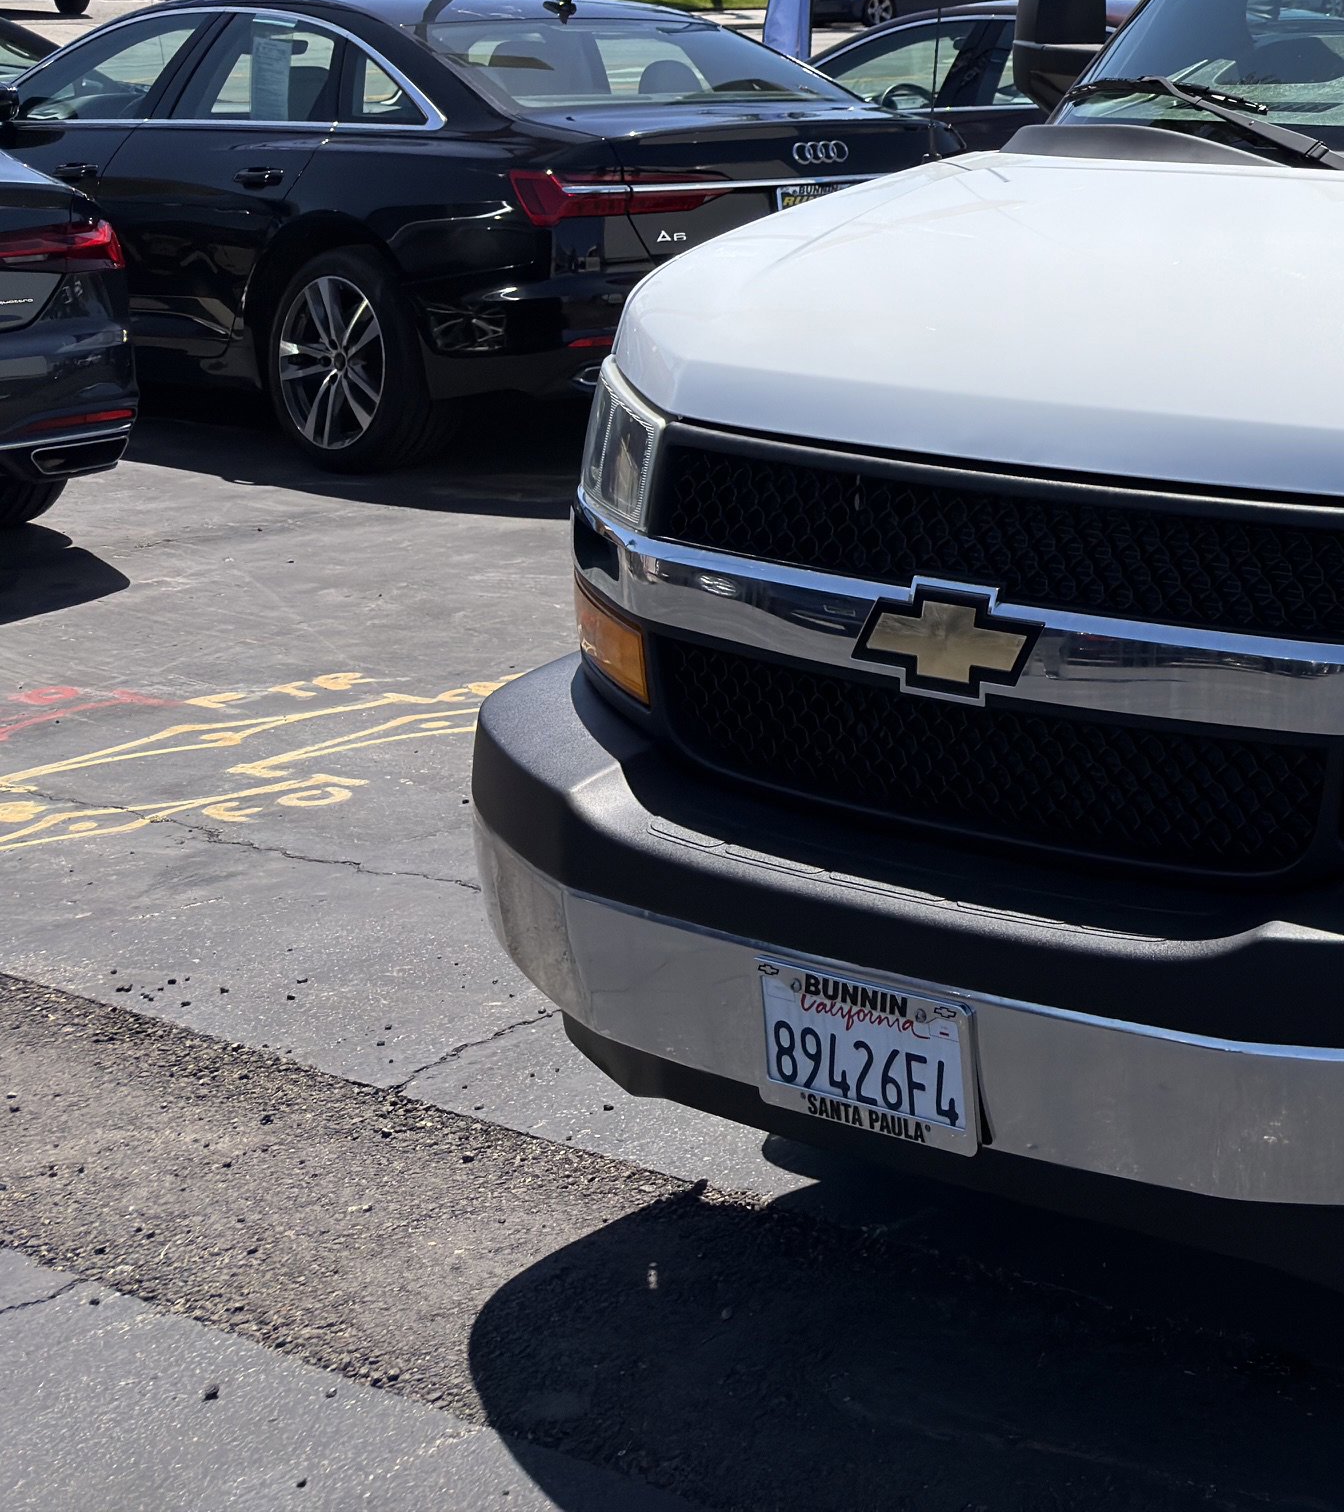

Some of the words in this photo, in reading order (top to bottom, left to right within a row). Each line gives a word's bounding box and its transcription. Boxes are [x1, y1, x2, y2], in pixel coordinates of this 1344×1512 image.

[656, 230, 687, 242] A6
[800, 994, 930, 1040] California
[804, 973, 908, 1018] BUNNIN
[773, 1019, 959, 1128] 89426F4
[807, 1093, 864, 1127] SANTA
[868, 1110, 926, 1143] PAULA
